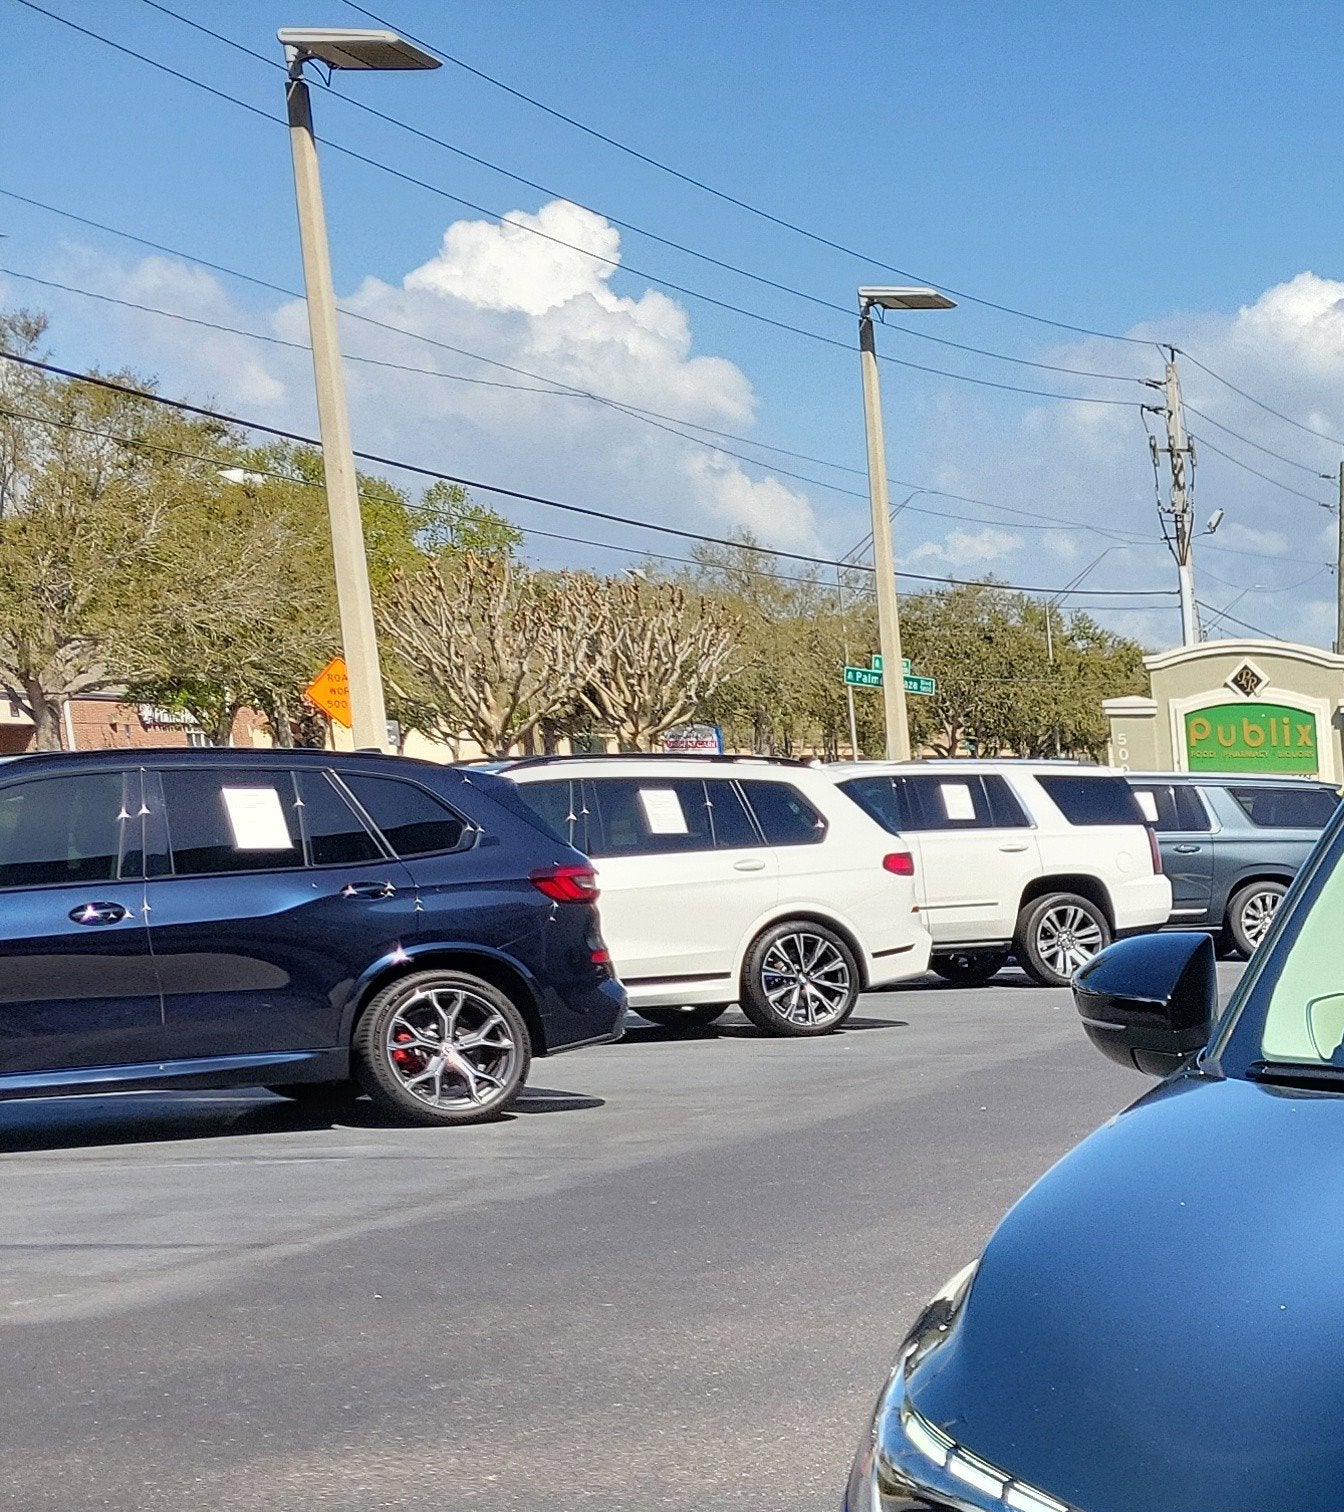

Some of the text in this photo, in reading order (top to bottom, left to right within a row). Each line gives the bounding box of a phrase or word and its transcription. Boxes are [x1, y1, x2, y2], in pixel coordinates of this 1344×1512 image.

[327, 673, 347, 681] ROA
[330, 687, 349, 695] WOR
[1189, 717, 1313, 747] Publix
